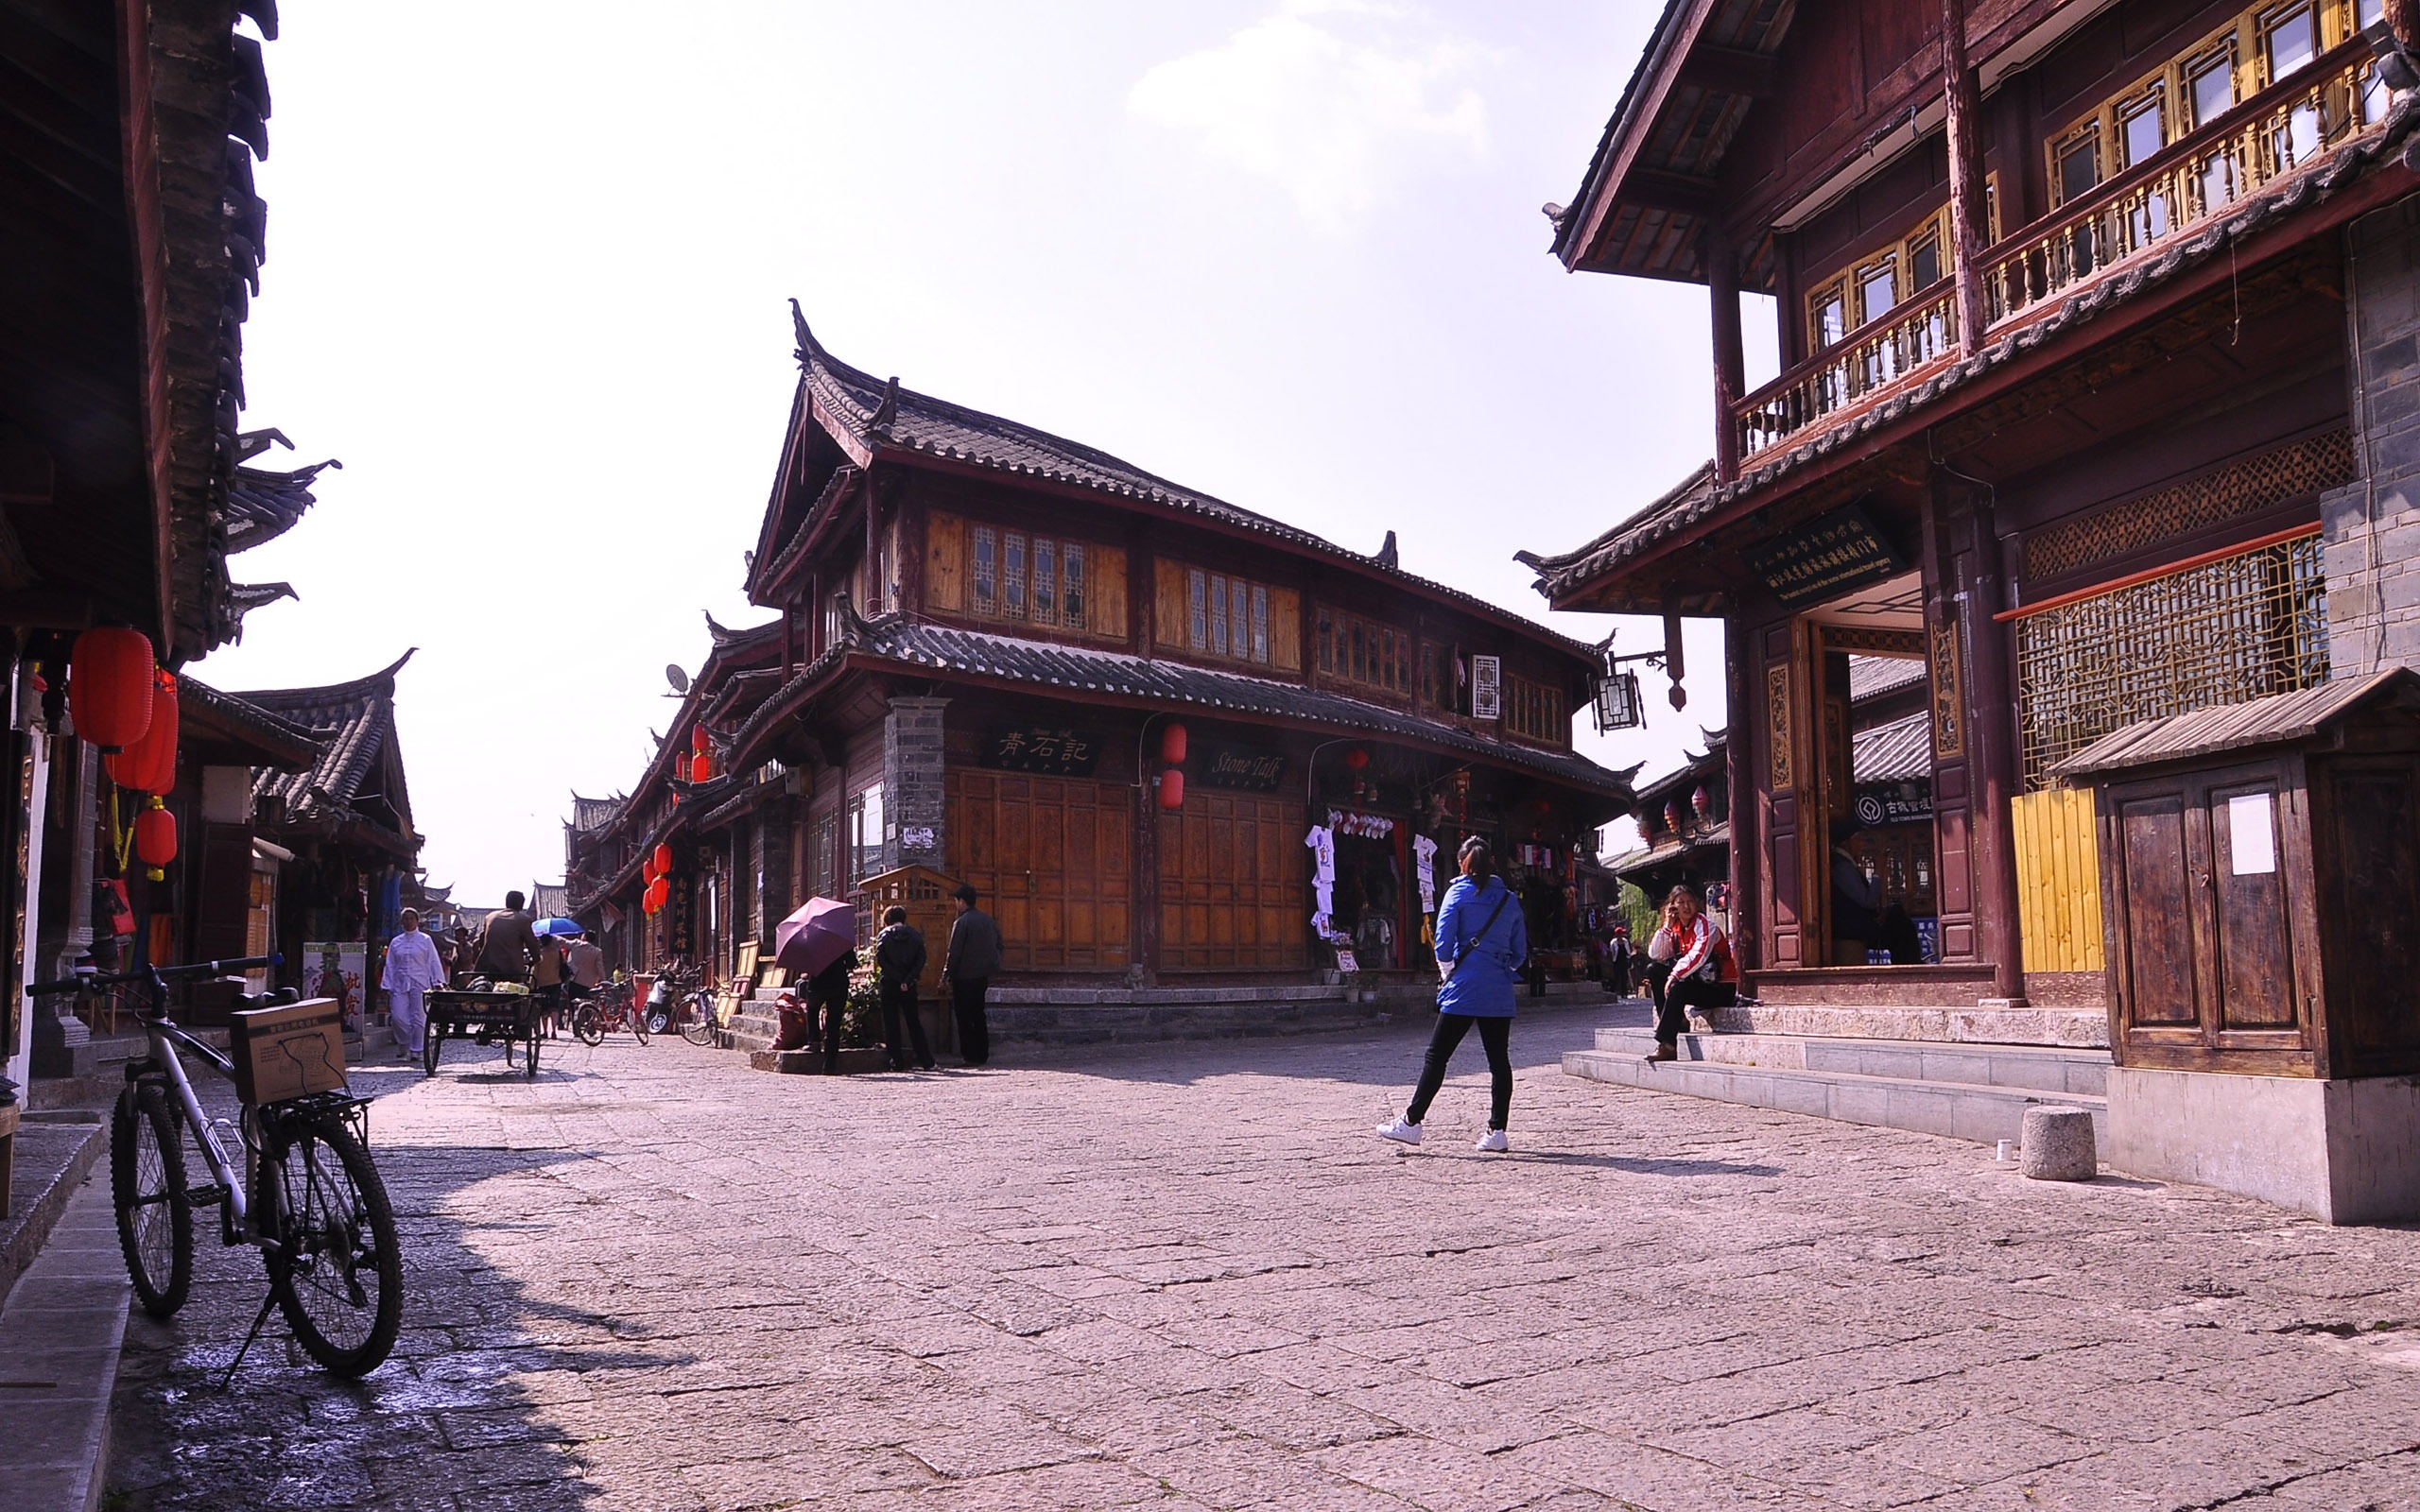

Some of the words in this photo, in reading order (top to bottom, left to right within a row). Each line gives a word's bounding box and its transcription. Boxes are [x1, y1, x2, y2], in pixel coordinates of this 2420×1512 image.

[999, 731, 1090, 762] 青石記
[1212, 751, 1252, 773] Stone
[1252, 755, 1284, 784] Talk
[1886, 796, 1934, 814] 古城管理
